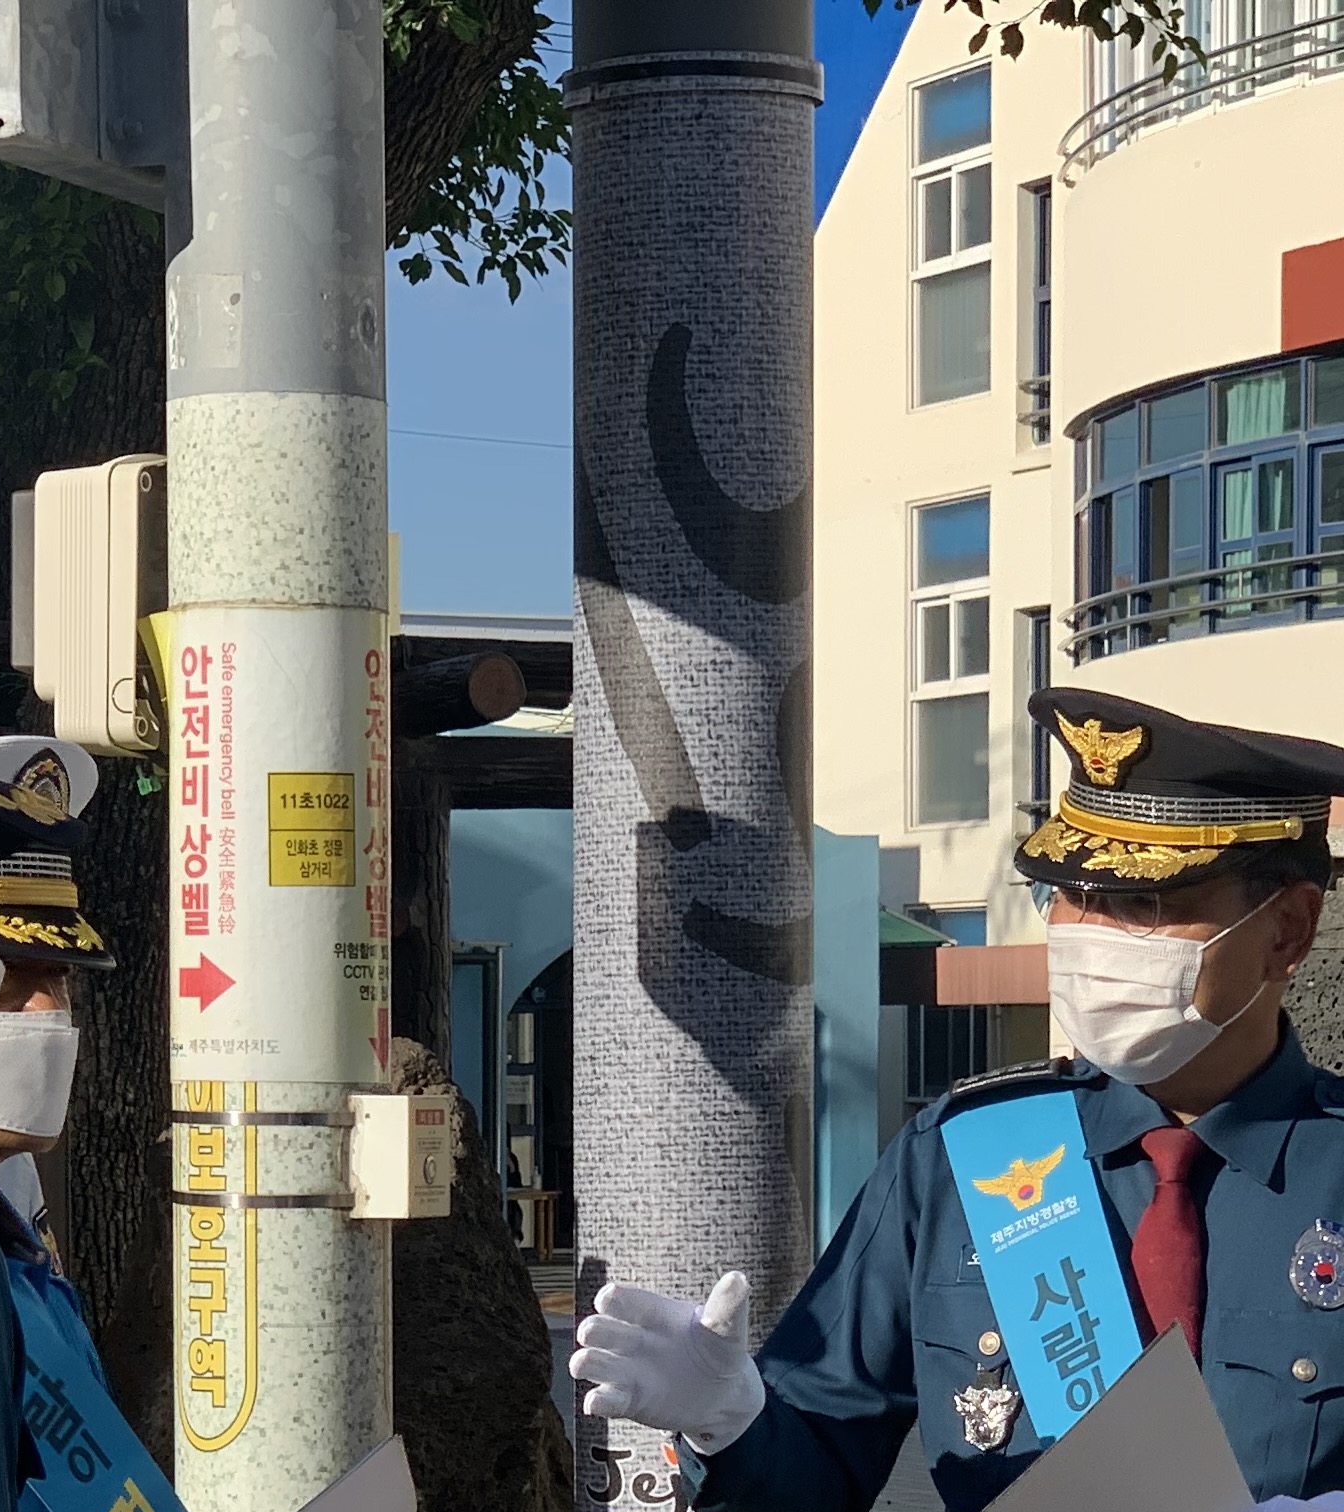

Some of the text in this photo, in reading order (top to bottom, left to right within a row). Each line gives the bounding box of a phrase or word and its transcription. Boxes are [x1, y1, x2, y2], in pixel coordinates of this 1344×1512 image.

[221, 642, 236, 682] Safe
[218, 687, 233, 788] emergency
[180, 644, 213, 936] 안전비상벨
[220, 790, 236, 820] bell
[281, 792, 349, 809] 11초1022
[299, 861, 332, 878] 삼거리
[343, 964, 375, 979] CCTV
[990, 1195, 1078, 1245] 제주지방경찰청
[1029, 1256, 1107, 1412] 사람이
